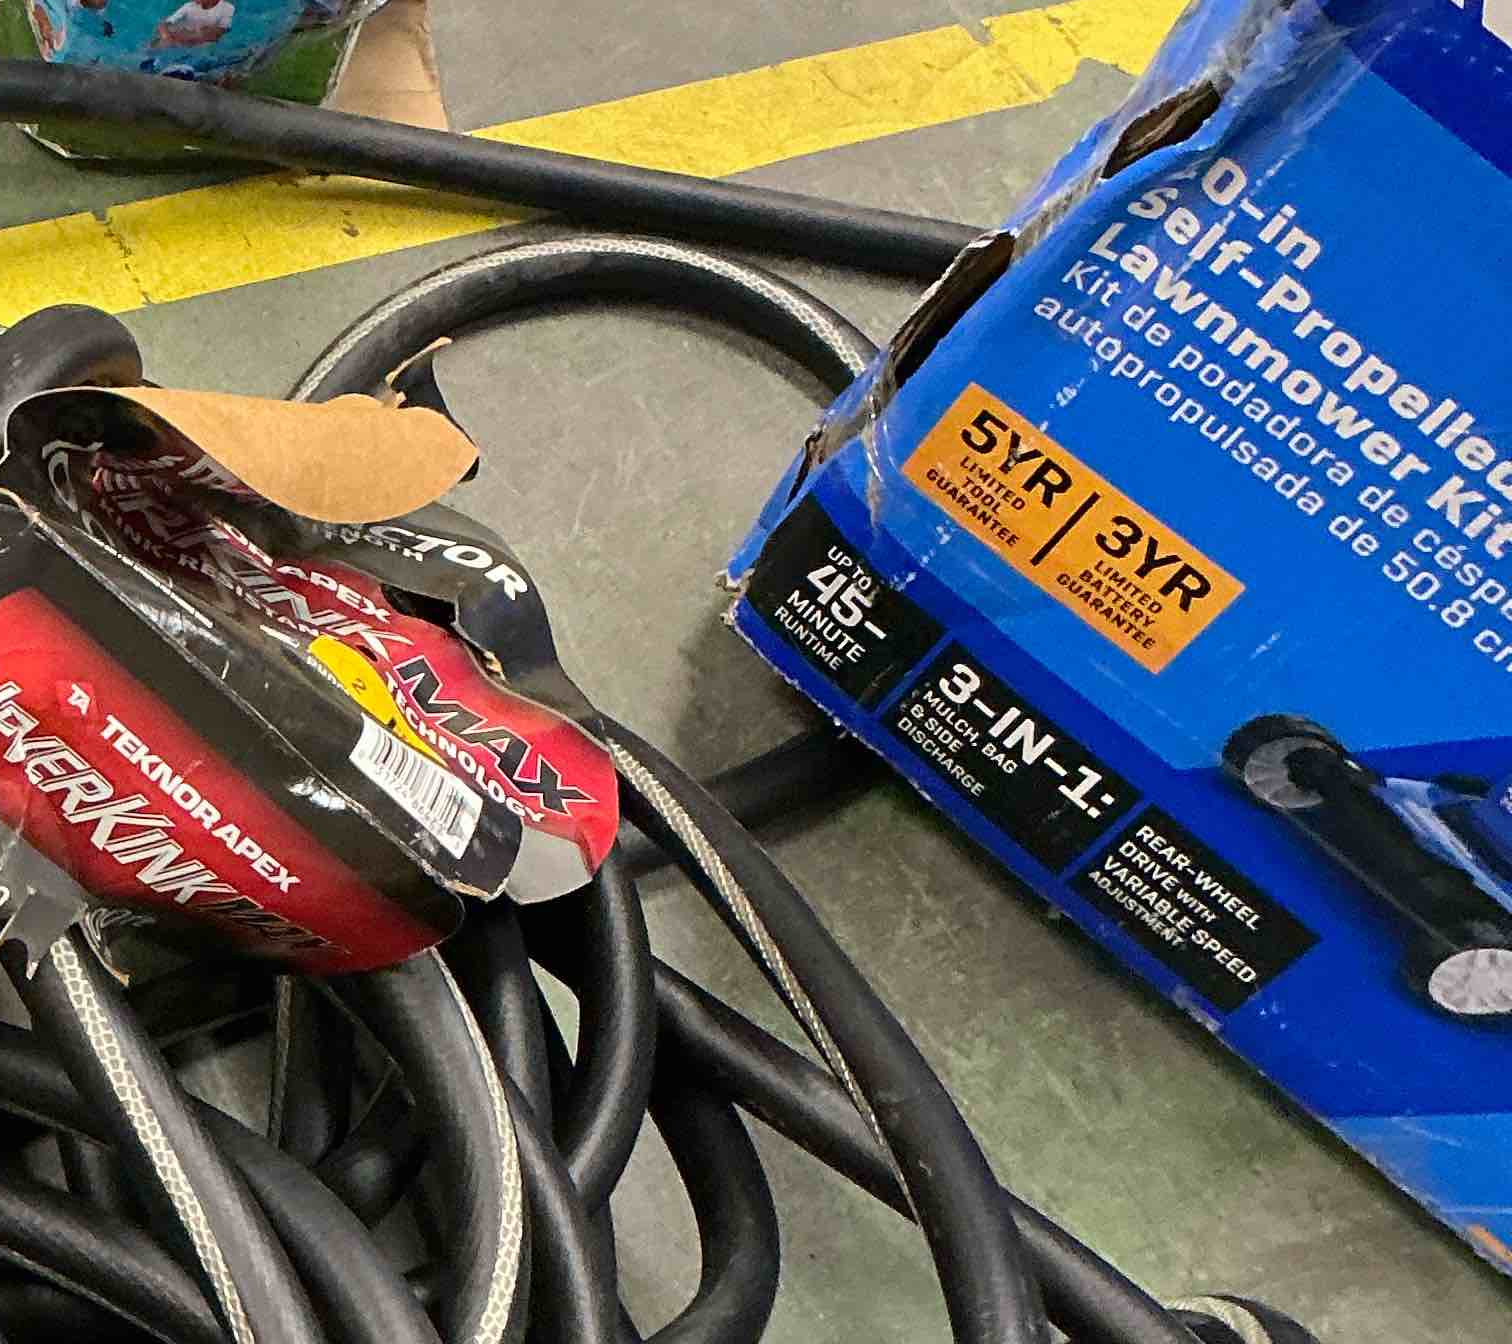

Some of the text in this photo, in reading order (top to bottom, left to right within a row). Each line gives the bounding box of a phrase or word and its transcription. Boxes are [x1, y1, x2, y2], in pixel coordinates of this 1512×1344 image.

[1060, 258, 1122, 307] Kit
[1121, 303, 1172, 348] de
[1168, 342, 1356, 489] podadora
[1357, 484, 1410, 529] de
[1088, 221, 1512, 560] Lawnmower Kit
[959, 455, 1027, 512] LIMITED
[961, 476, 1002, 517] TOOL
[1033, 293, 1327, 517] autopropulsada
[1327, 511, 1381, 559] de
[1382, 549, 1476, 629] 50.8
[925, 467, 1021, 548] GUARANTEE
[960, 408, 1212, 614] 5YR 3YR
[276, 564, 392, 624] APEX
[826, 544, 872, 592] UP TO
[1078, 568, 1157, 629] BATTERY
[1092, 559, 1163, 615] LIMITED
[773, 605, 845, 672] RUNTIME
[785, 589, 867, 664] MINUTE
[1055, 572, 1157, 651] GUARANTEE
[384, 671, 546, 824] TECHNOLOGY
[393, 654, 600, 817] MAX
[896, 716, 986, 798] DISCHARGE
[922, 689, 1019, 775] MULCH, BAG
[922, 713, 964, 754] SIDE
[938, 662, 1116, 819] 3-IN-1:
[99, 713, 226, 832] TEKNOR
[210, 821, 302, 894] APEX
[1087, 870, 1186, 947] ADJUSTMENT
[1117, 840, 1218, 924] DRIVE WITH
[1135, 824, 1265, 932] REAR-WHEEL
[1102, 855, 1258, 984] VARIABLE SPEED
